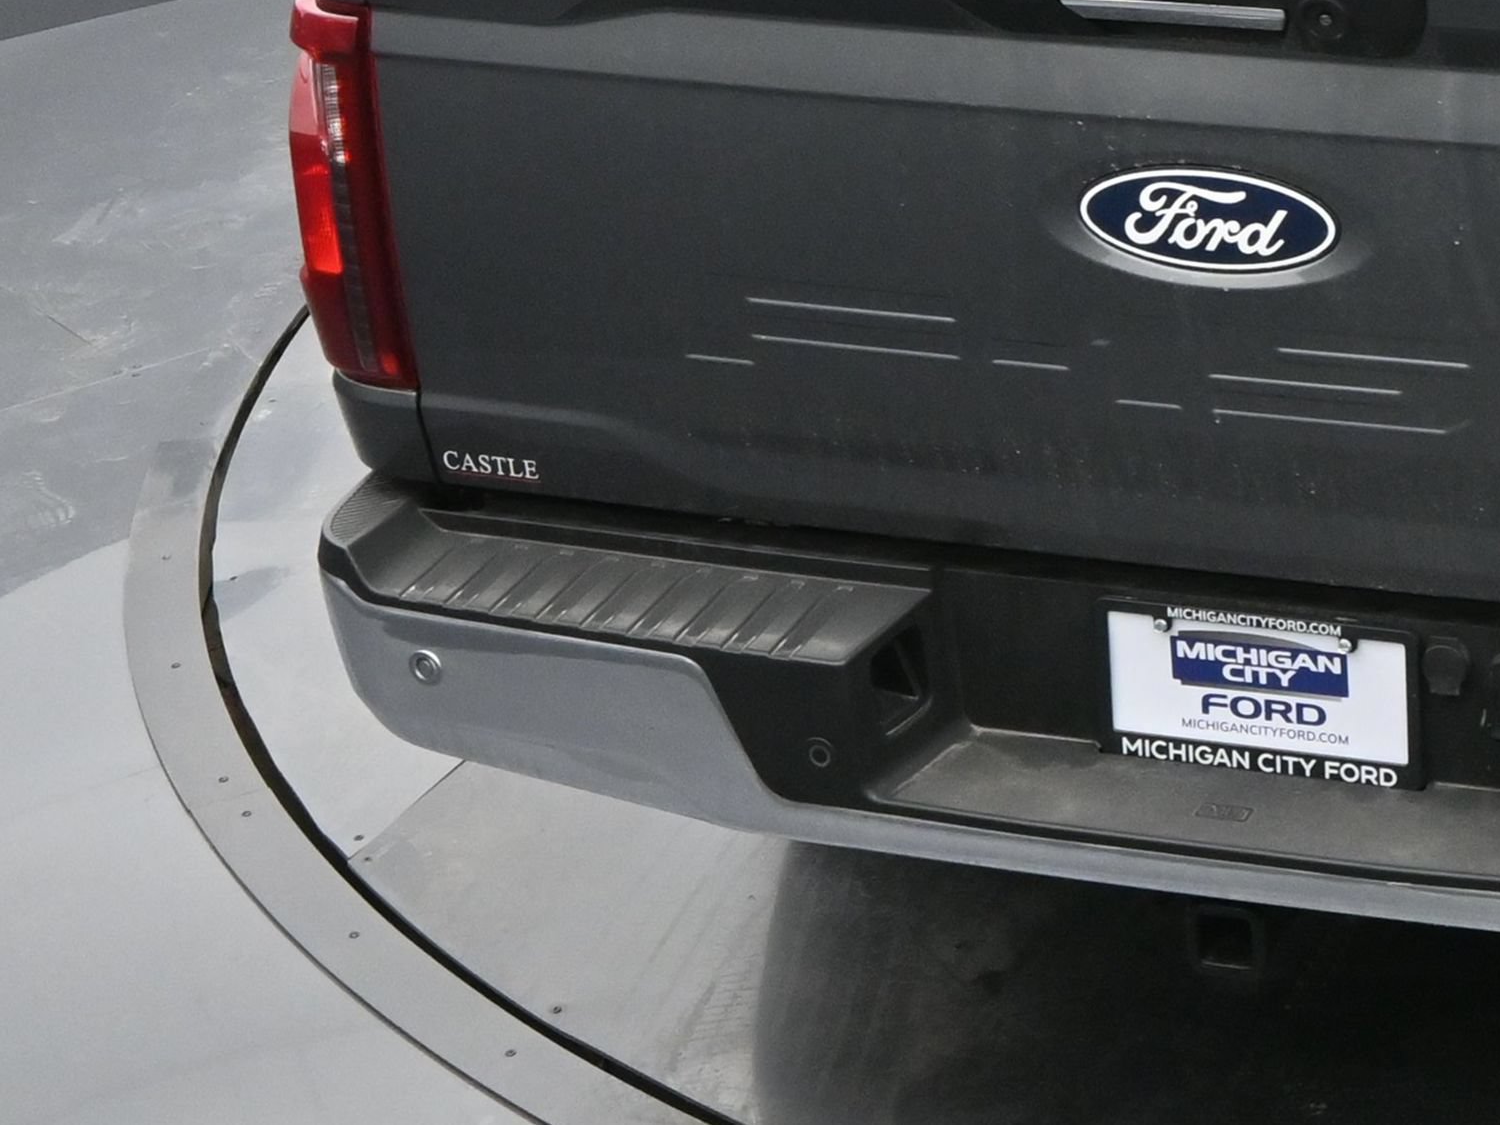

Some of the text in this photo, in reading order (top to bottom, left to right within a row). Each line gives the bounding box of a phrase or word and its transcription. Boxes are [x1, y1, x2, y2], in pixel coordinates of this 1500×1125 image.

[1124, 181, 1288, 256] Ford
[443, 450, 540, 480] CASTLE
[1166, 606, 1342, 637] MICHIGANCITYFORD.COM
[1175, 640, 1341, 675] MICHIGAN
[1222, 663, 1297, 687] CITY
[1201, 693, 1327, 726] FORD
[1181, 717, 1349, 745] MICHIGANCITYFORD.COM
[1121, 736, 1398, 788] MICHIGAN CITY FORD
